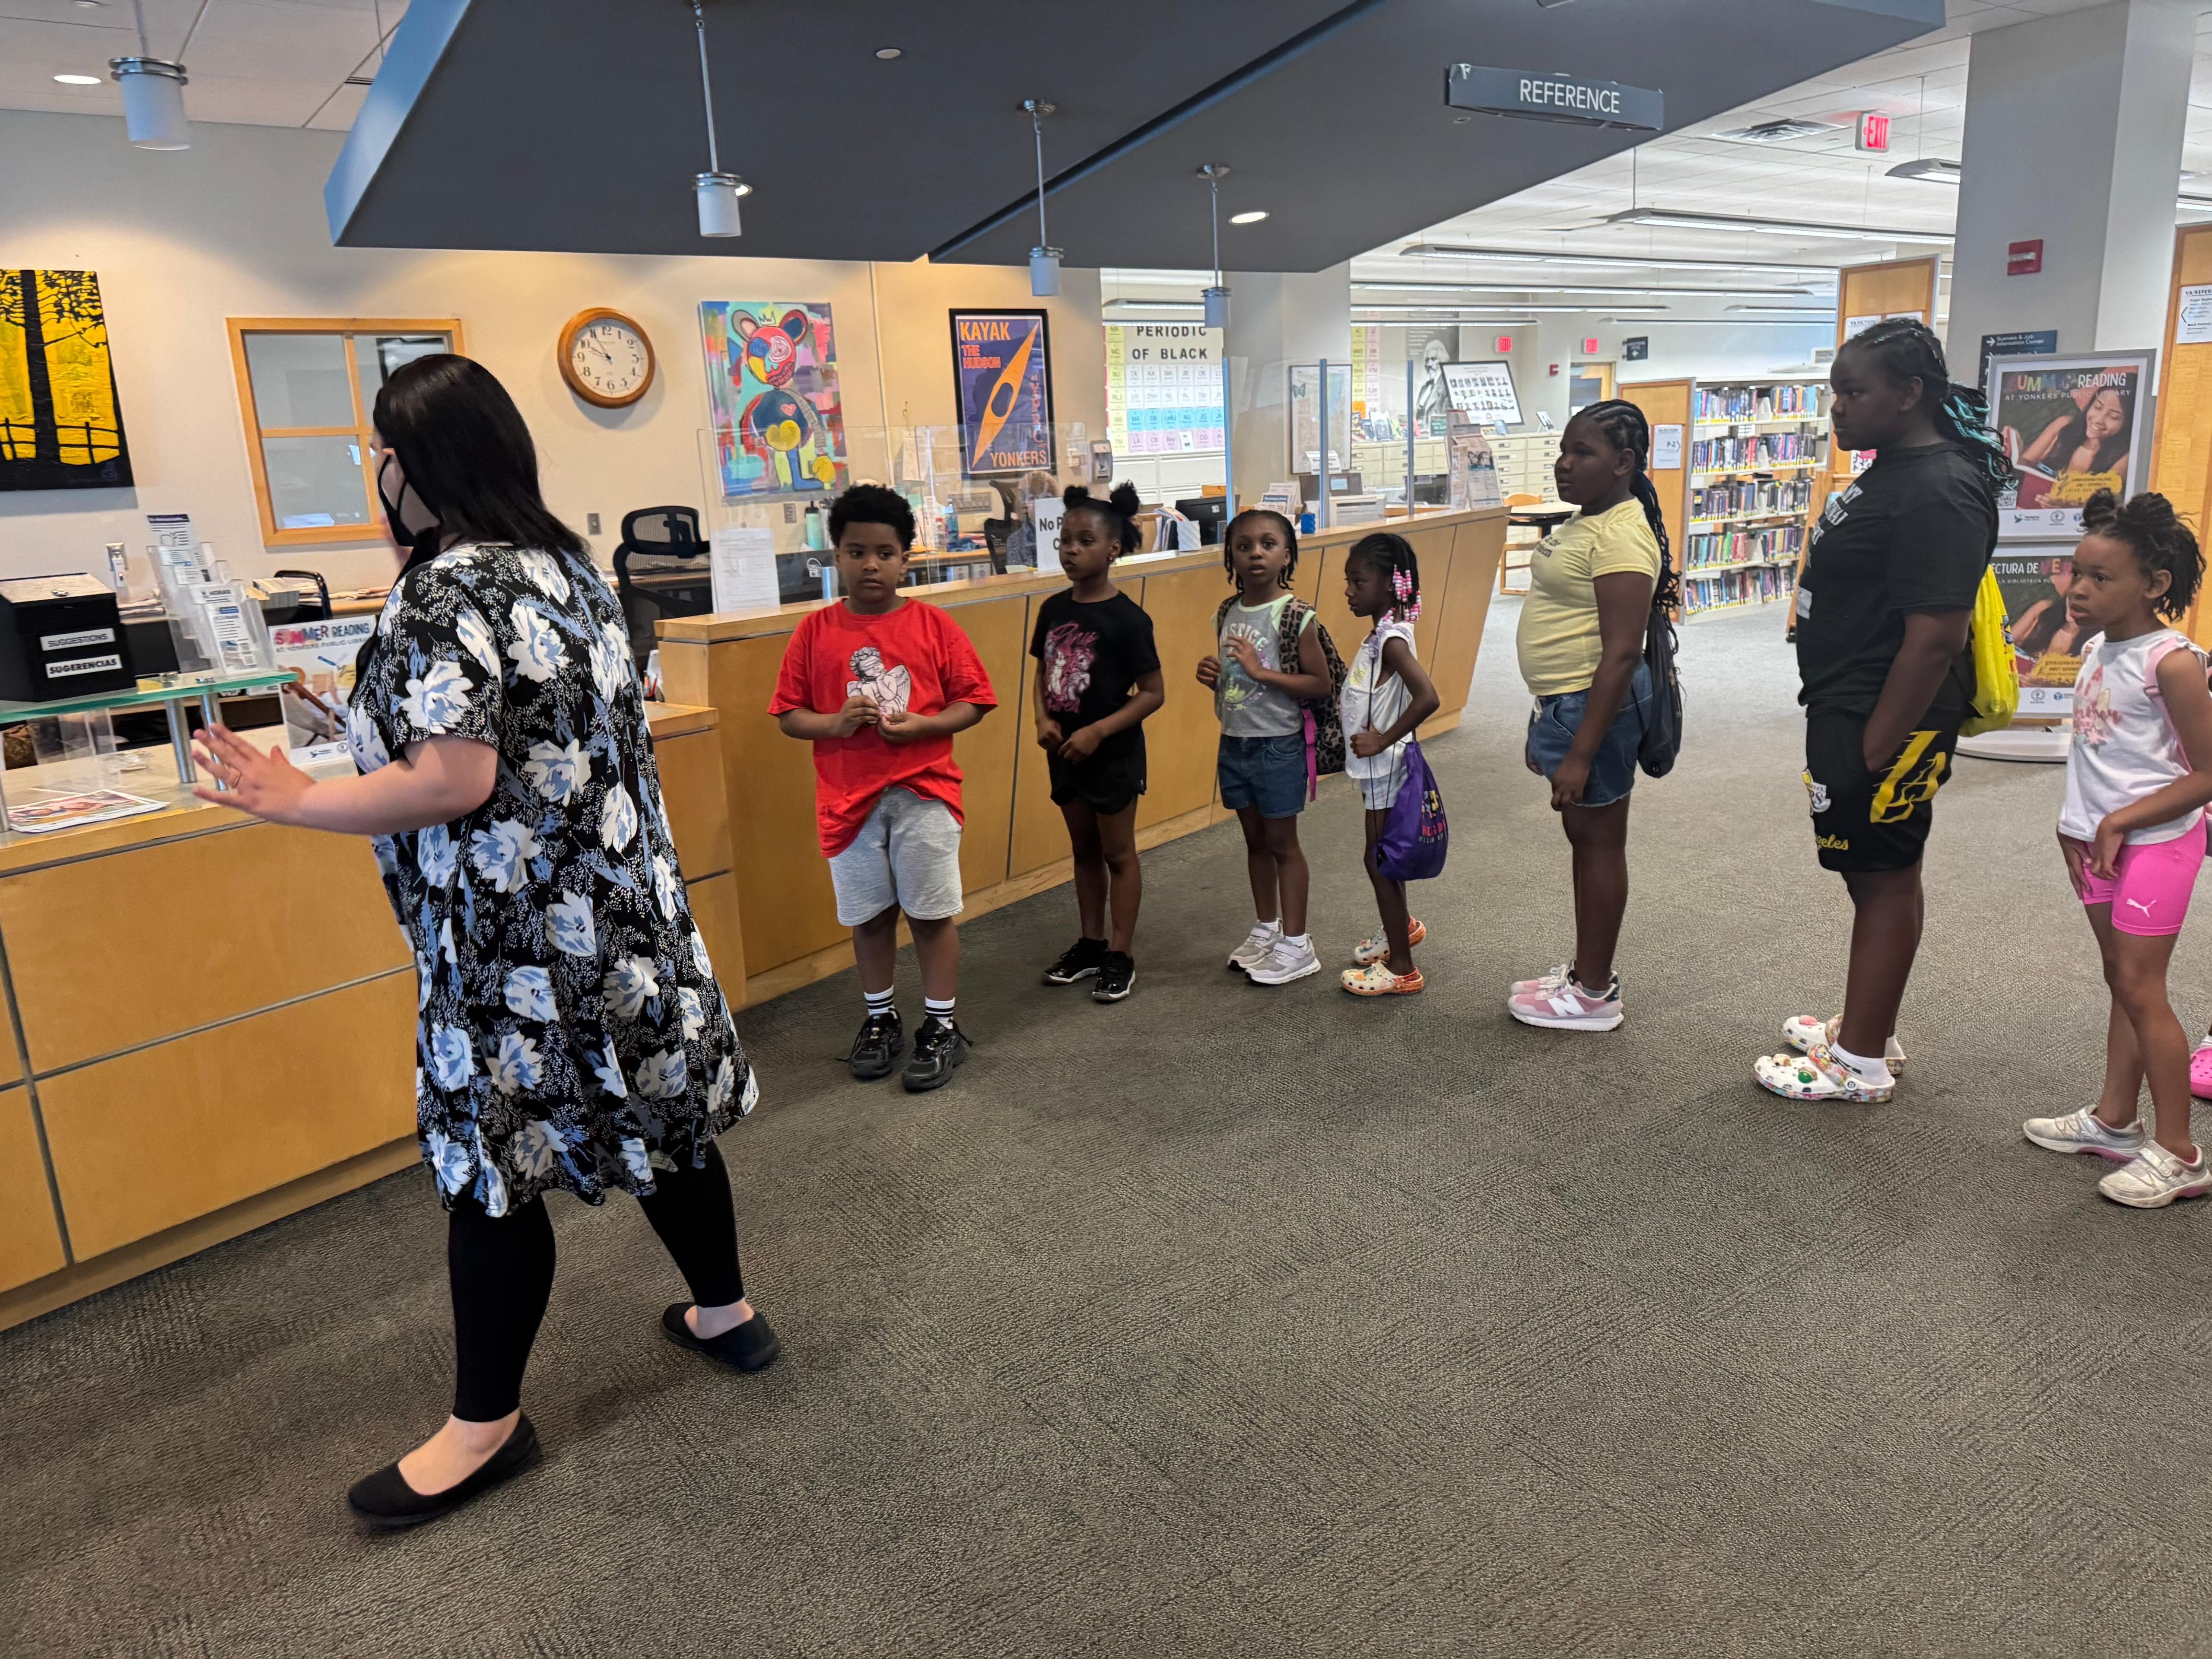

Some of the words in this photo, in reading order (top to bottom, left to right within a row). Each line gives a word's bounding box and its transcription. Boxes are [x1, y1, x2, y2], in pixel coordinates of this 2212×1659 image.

[1520, 79, 1620, 114] REFERENCE
[1867, 115, 1889, 149] EXIT
[602, 326, 612, 336] 12
[960, 322, 1011, 341] KAYAK
[577, 352, 585, 362] 9
[962, 345, 980, 357] THE
[1132, 349, 1149, 359] OF
[1161, 348, 1208, 359] BLACK
[963, 356, 1001, 369] HUDSON
[583, 367, 591, 376] 8
[595, 377, 601, 386] 7
[607, 380, 615, 390] 6
[2078, 372, 2126, 388] READING
[990, 450, 1047, 467] YONKERS
[1039, 518, 1054, 531] No
[1991, 563, 2024, 574] ECTURA
[2027, 562, 2039, 574] DE
[332, 623, 369, 638] READING
[48, 633, 108, 647] SUGGESTIONS
[49, 658, 117, 674] SUGERENCIAS
